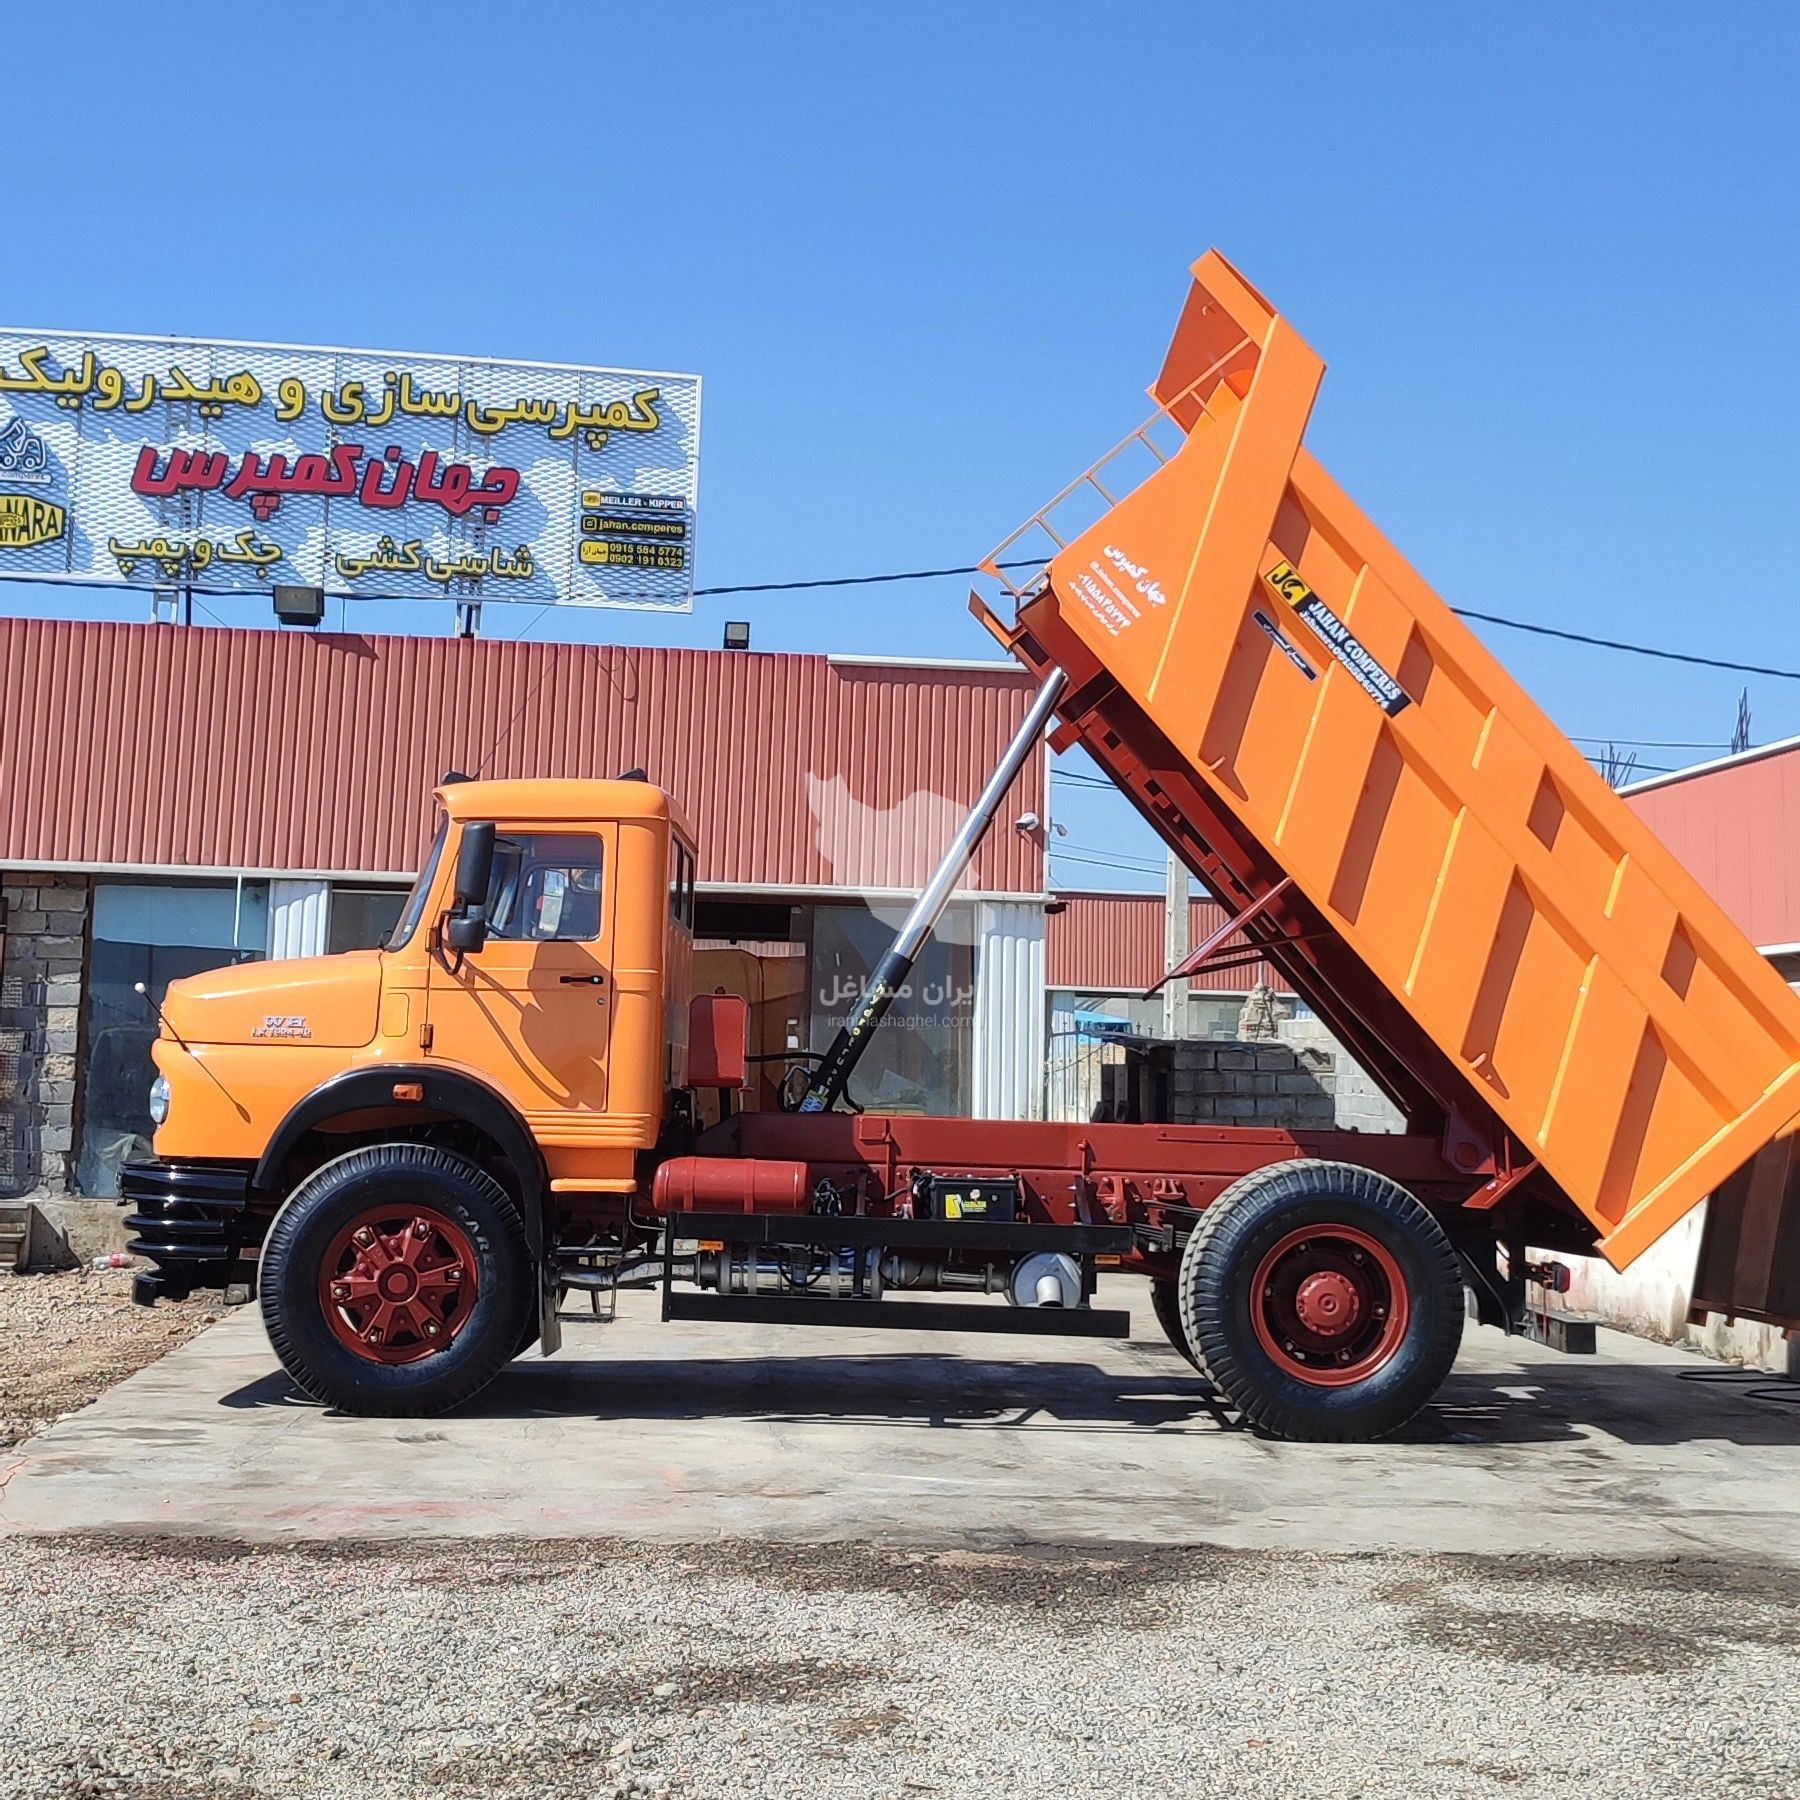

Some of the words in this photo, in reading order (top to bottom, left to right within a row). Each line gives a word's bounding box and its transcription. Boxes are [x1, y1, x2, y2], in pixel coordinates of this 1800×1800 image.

[0, 346, 262, 418] هیدرولیک
[275, 377, 306, 422] و
[321, 371, 461, 425] سازی
[466, 387, 660, 451] کمپرسی
[131, 444, 364, 520] کمپرس
[359, 445, 521, 523] جهان
[600, 496, 642, 507] MEILLER
[109, 537, 188, 576] پمپ
[190, 538, 212, 569] و
[216, 531, 282, 577] جک
[336, 535, 422, 577] کشی
[425, 544, 535, 579] شاسی
[609, 543, 634, 553] 0915
[1308, 601, 1349, 642] JAHAN
[1344, 639, 1402, 700] COMPERES
